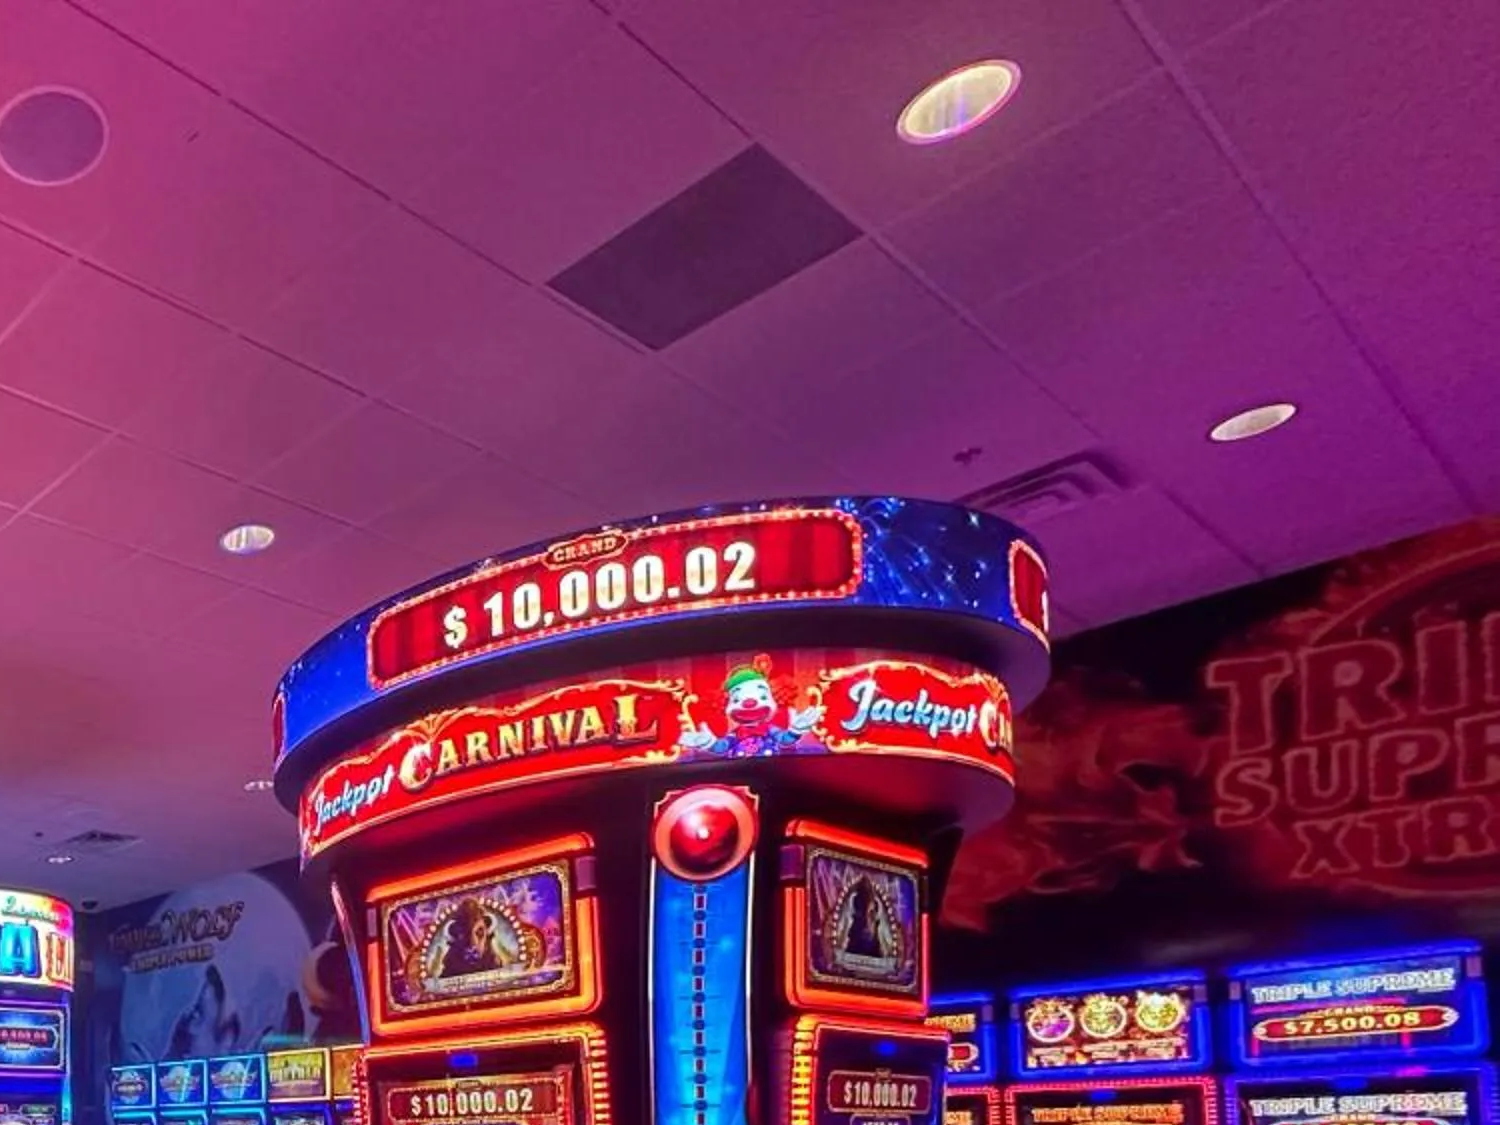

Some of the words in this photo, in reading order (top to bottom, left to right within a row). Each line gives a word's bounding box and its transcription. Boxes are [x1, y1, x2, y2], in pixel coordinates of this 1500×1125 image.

[551, 535, 618, 565] GRAND
[443, 541, 756, 648] $10,000.02
[841, 676, 977, 739] Jackpot
[1206, 608, 1500, 757] TRI
[314, 762, 394, 835] Jackpot
[399, 694, 657, 792] CARNIVAL
[1252, 980, 1333, 1004] TRIPLE
[1336, 968, 1455, 994] SUPREME
[1250, 1096, 1334, 1117] TRIPLE
[1338, 1091, 1468, 1117] SUPREME
